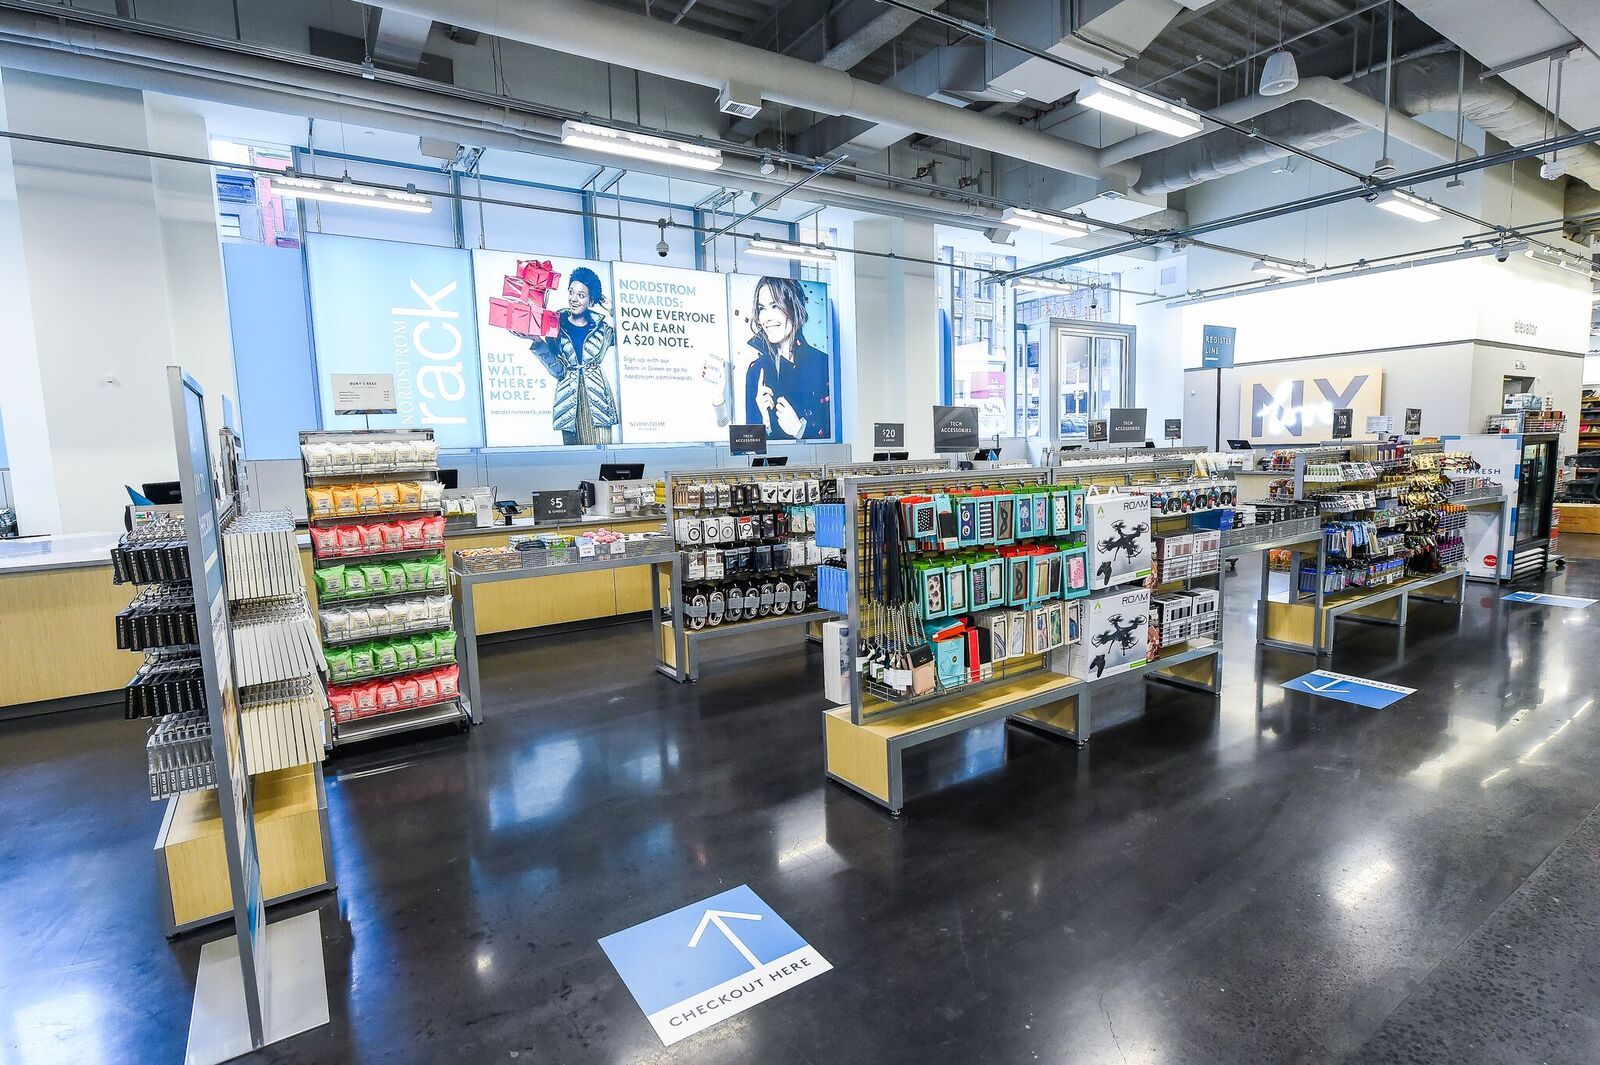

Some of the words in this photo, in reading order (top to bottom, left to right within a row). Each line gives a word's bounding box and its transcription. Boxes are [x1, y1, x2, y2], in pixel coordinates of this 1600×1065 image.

[619, 279, 696, 296] NORDSTROM
[620, 293, 683, 308] REWARDS:
[621, 307, 652, 318] NOW
[656, 309, 715, 323] EVERYONE
[621, 321, 649, 332] CAN
[653, 322, 685, 334] EARN
[1514, 319, 1538, 336] elevator
[623, 335, 631, 344] A
[634, 334, 655, 346] $20
[658, 336, 694, 348] NOTE.
[391, 278, 467, 425] rack
[1205, 346, 1220, 355] LINE
[487, 353, 515, 363] BUT
[392, 319, 415, 425] NORDSTROM
[487, 365, 527, 376] WAIT.
[488, 378, 547, 389] THERE'S
[490, 390, 536, 401] MORE.
[1251, 375, 1369, 438] NY
[882, 428, 896, 438] $20
[550, 497, 563, 509] $5
[1123, 500, 1149, 511] ROAM
[1121, 593, 1148, 605] ROAM
[669, 978, 766, 1027] CHECKOUT
[769, 957, 812, 982] HERE
